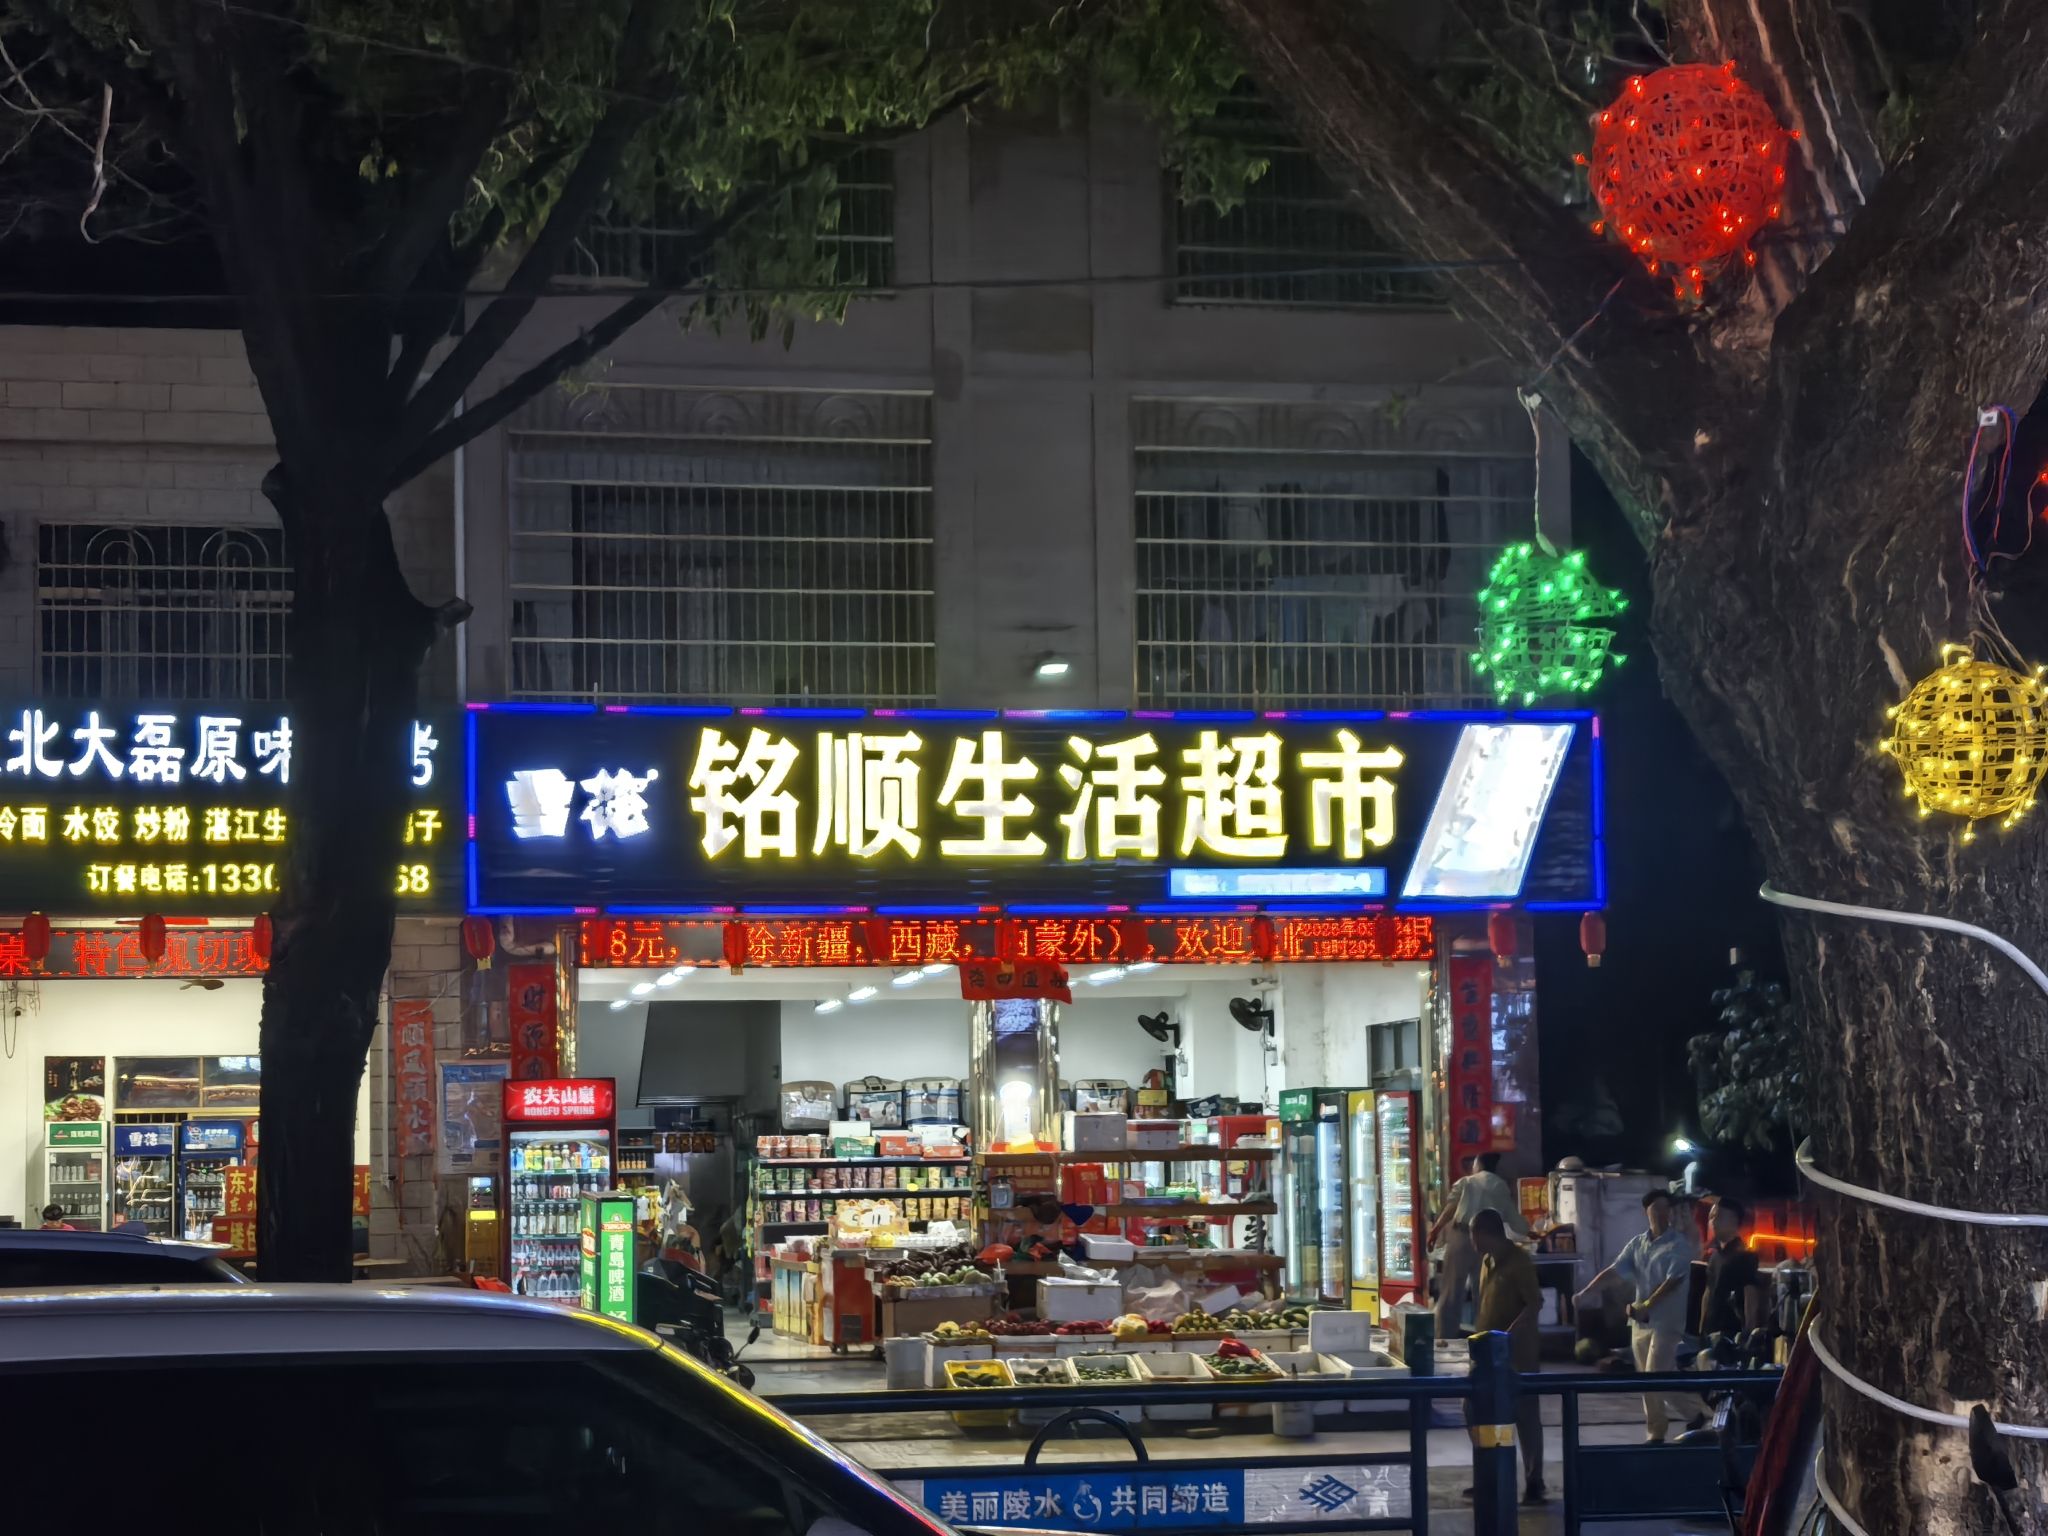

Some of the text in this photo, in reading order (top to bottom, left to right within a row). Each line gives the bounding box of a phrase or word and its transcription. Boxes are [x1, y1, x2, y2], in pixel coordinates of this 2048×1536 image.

[689, 728, 1404, 859] 铭顺生活超市
[63, 806, 119, 841] 水饺
[134, 806, 190, 841] 炒粉
[524, 1086, 595, 1105] 农夫山泉
[608, 1233, 625, 1303] 青岛啤酒
[940, 1489, 1062, 1523] 美丽陵水
[1110, 1481, 1231, 1517] 共同缔造
